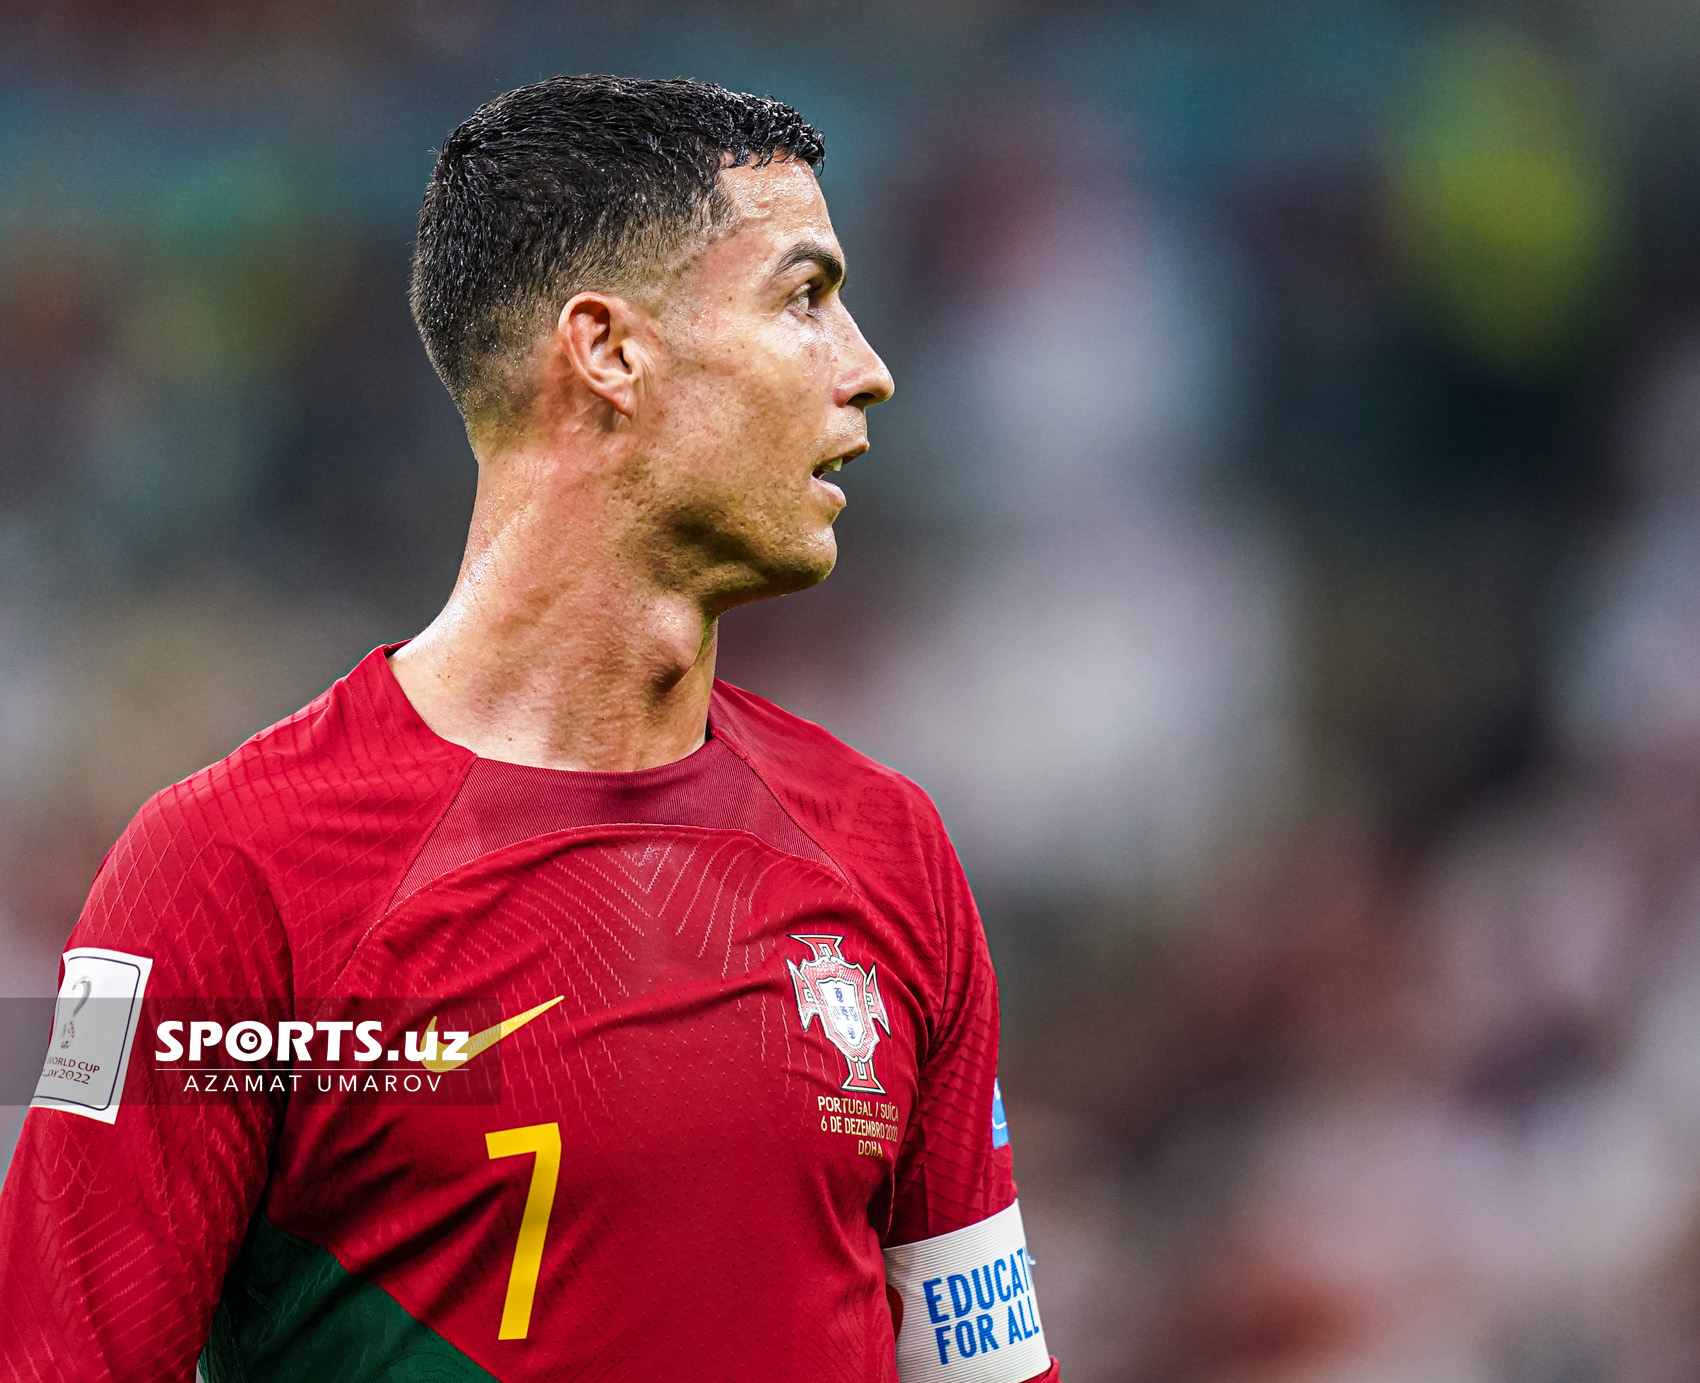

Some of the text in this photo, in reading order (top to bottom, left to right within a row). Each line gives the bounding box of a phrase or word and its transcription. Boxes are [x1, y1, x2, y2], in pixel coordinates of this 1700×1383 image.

[77, 1061, 100, 1073] CUP
[817, 1096, 873, 1117] PORTUGAL
[820, 1115, 828, 1132] 6
[829, 1115, 843, 1134] DE
[844, 1117, 885, 1139] DEZEMBRO
[858, 1139, 883, 1157] DOHA
[485, 1122, 562, 1341] 7
[922, 1247, 1030, 1324] EDUCAT
[934, 1295, 1040, 1366] FOR ALL
